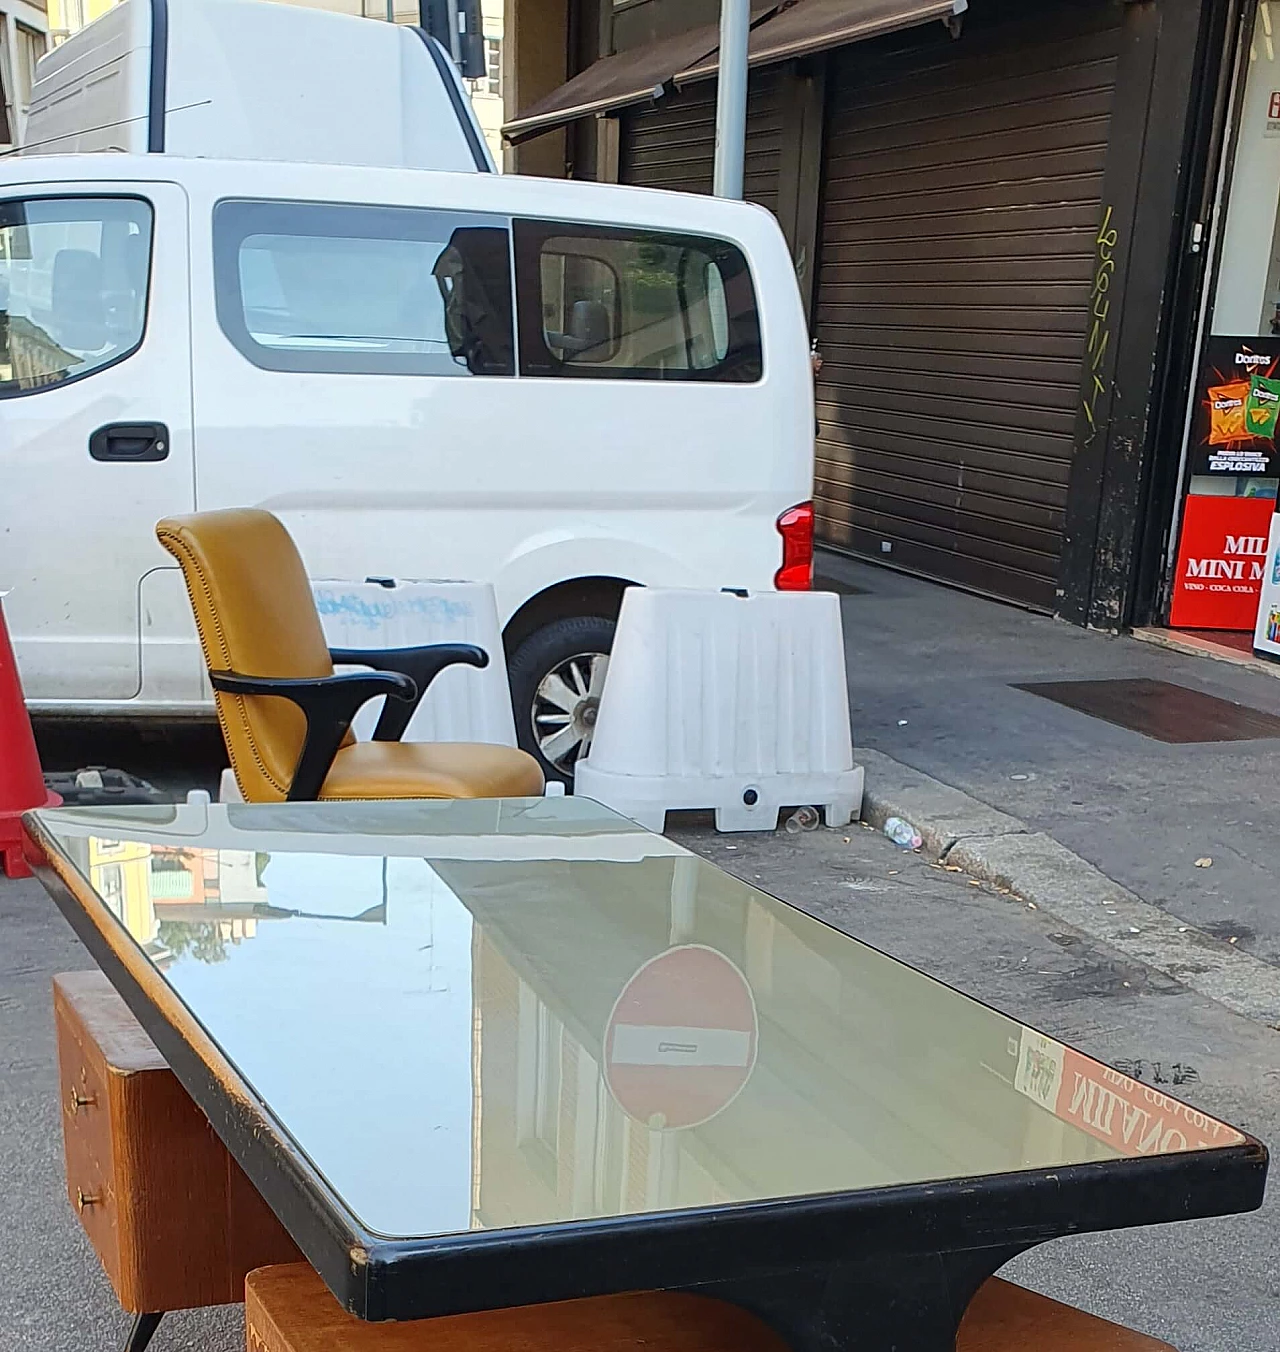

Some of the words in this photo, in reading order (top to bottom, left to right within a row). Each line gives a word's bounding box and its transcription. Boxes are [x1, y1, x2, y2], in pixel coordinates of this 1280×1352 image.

[1235, 353, 1271, 365] Doritos
[1210, 461, 1266, 472] ESPLOSIVA
[1185, 558, 1245, 579] MINI
[1184, 582, 1205, 591] VINO
[1209, 584, 1232, 592] COCA
[1232, 585, 1254, 594] COLA
